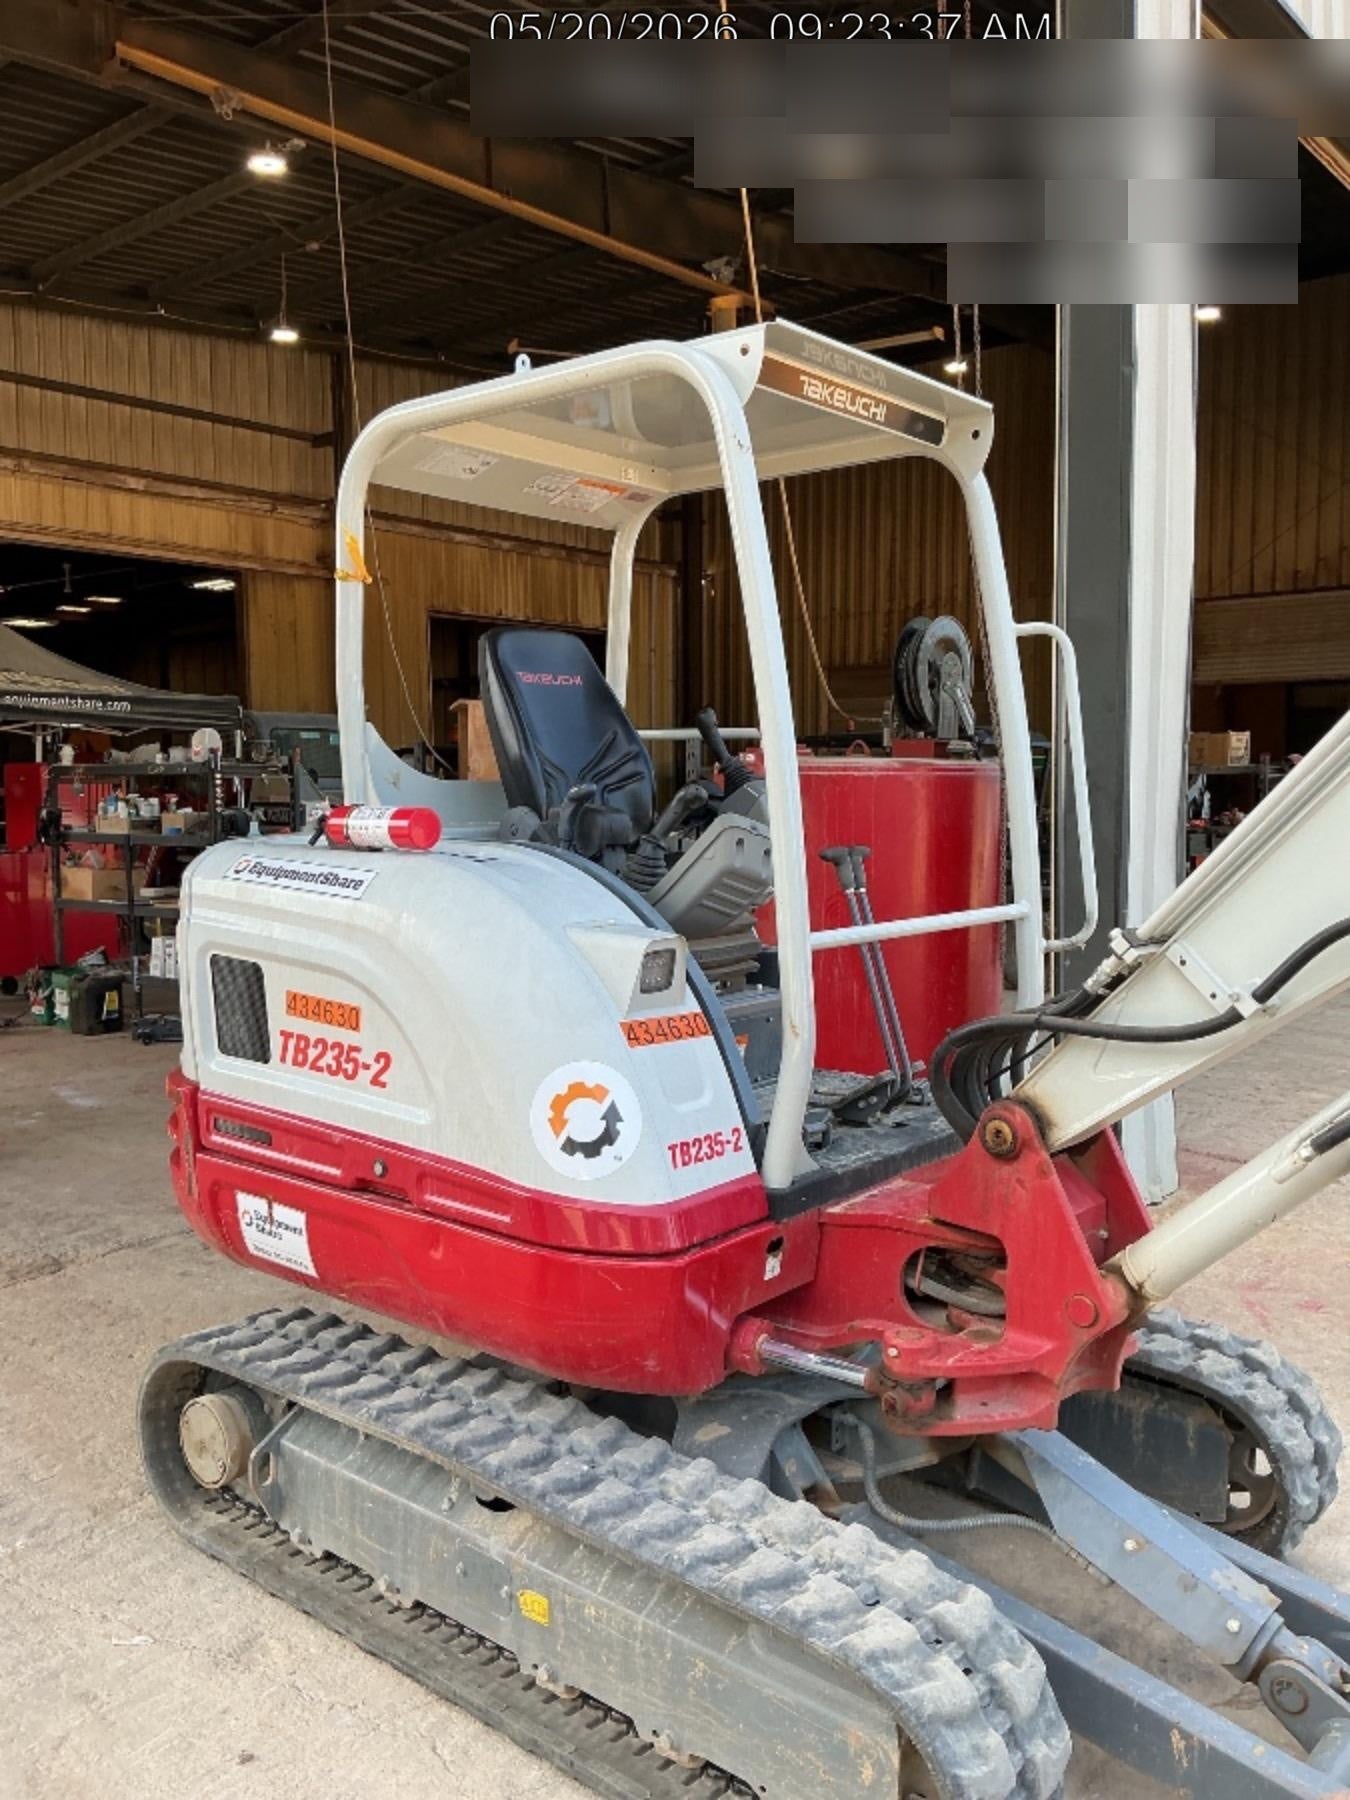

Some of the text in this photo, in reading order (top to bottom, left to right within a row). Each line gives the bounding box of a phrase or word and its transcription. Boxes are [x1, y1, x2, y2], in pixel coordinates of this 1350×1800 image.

[248, 861, 364, 891] EquipmentShare
[286, 993, 360, 1031] 434630
[627, 1013, 709, 1045] 434630
[279, 1029, 392, 1089] TB235-2
[667, 1126, 744, 1171] TB235-2
